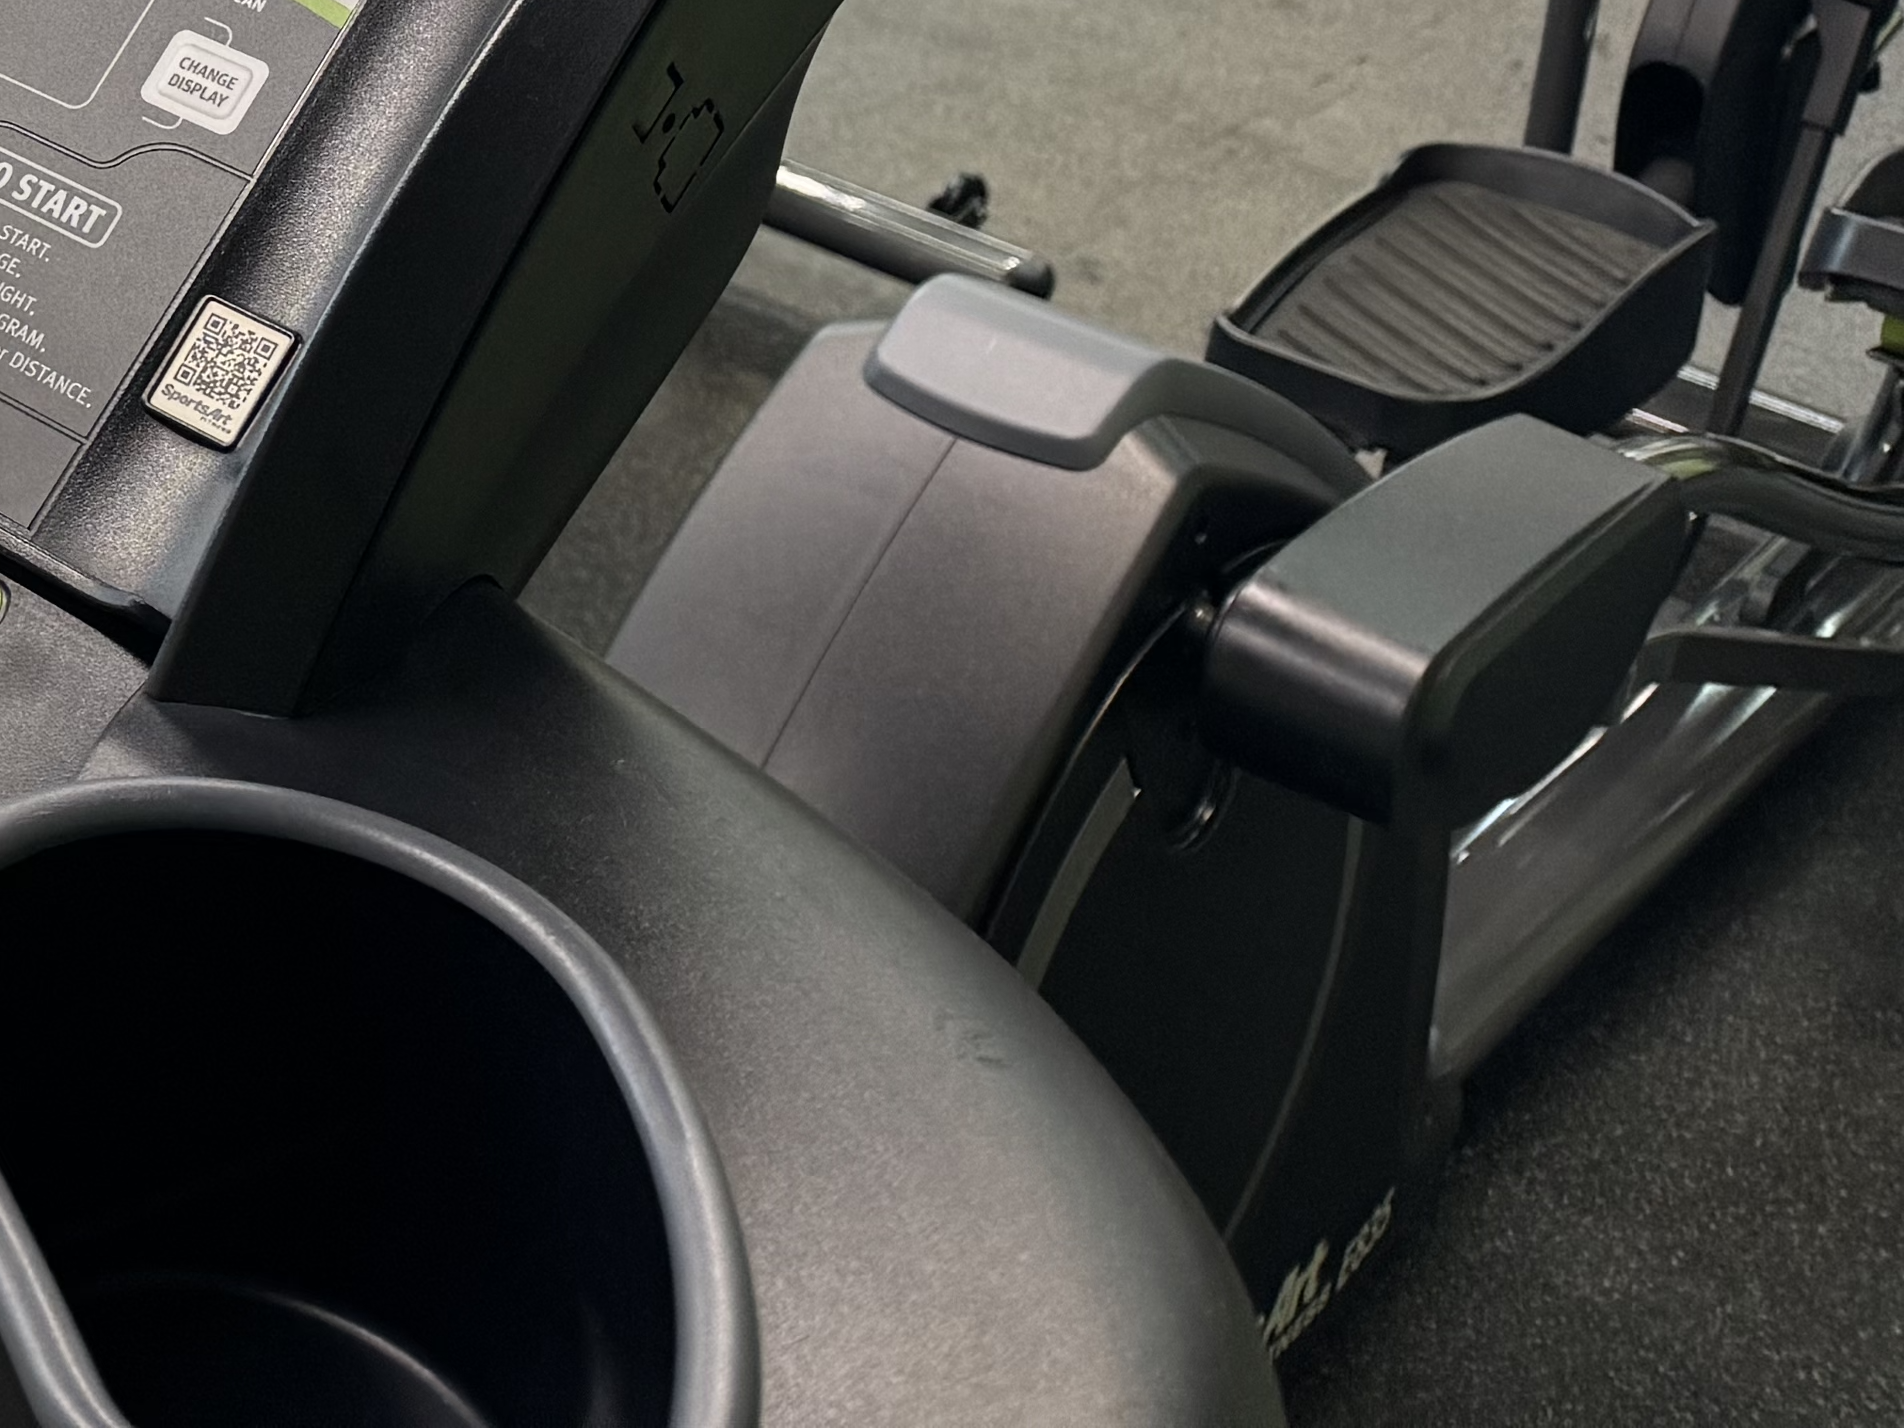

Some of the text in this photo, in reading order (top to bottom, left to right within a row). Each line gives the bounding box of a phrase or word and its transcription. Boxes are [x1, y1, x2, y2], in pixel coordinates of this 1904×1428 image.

[167, 73, 229, 108] DISPLAY
[178, 56, 238, 91] CHANGE
[11, 173, 107, 233] START
[8, 351, 91, 408] DISTANCE.
[160, 383, 232, 426] SportsArt
